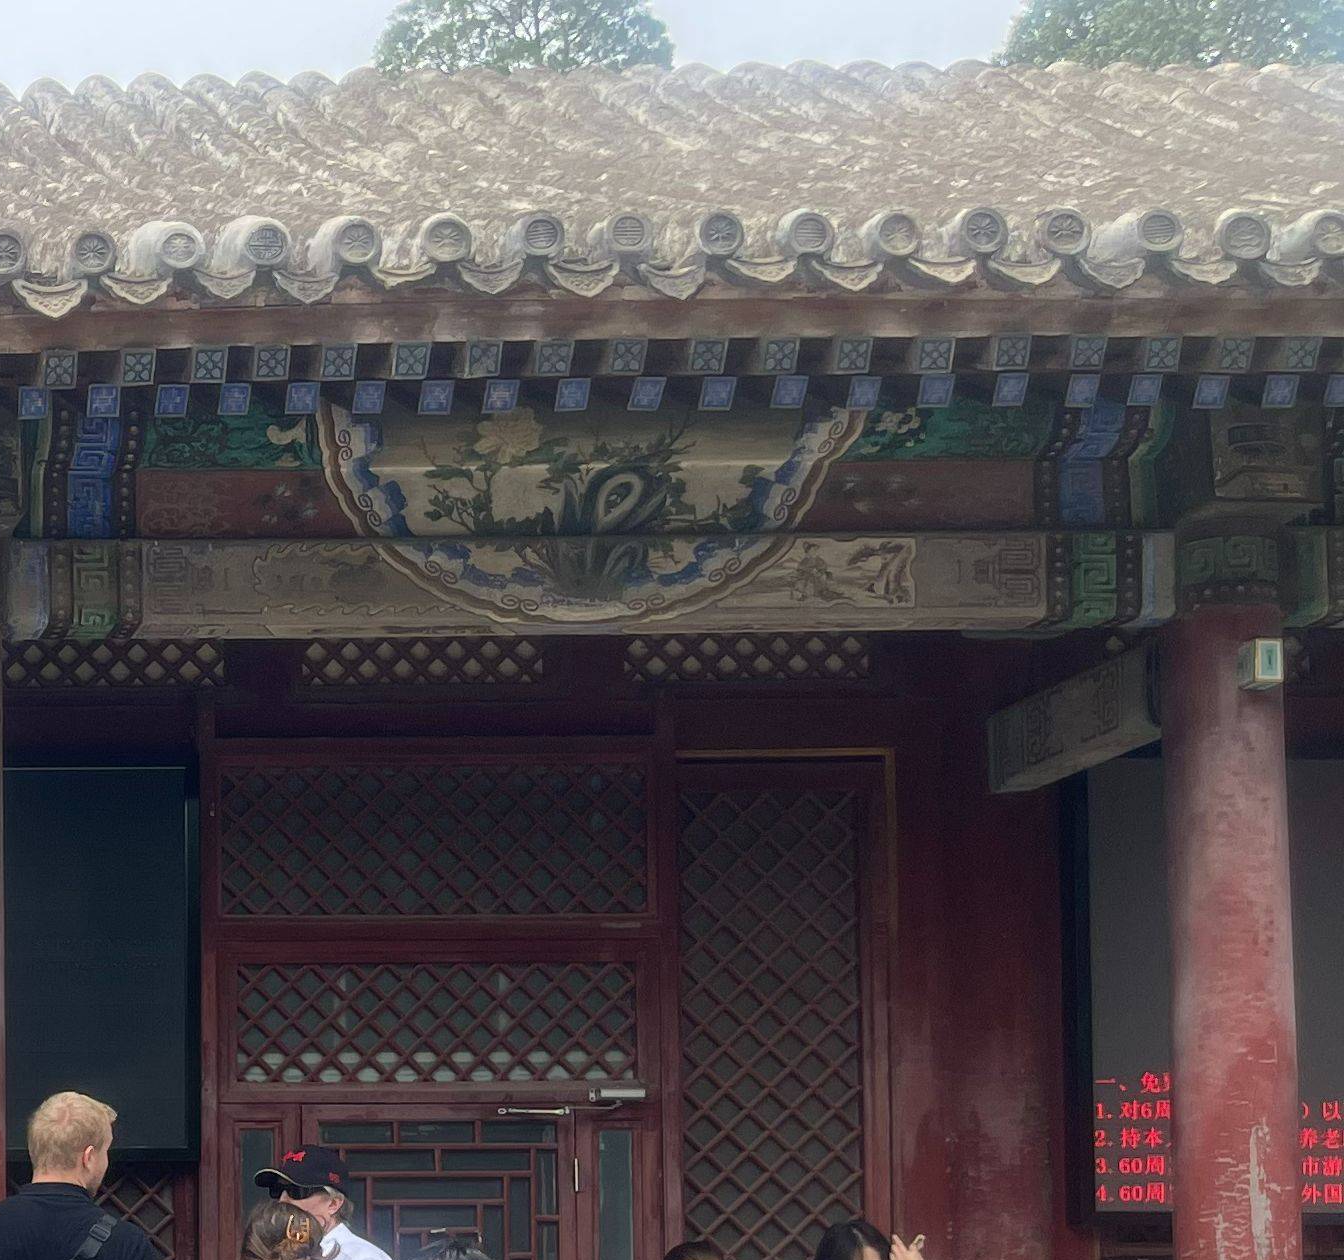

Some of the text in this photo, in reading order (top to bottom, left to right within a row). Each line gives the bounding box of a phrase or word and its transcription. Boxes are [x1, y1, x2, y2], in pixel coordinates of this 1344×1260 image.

[1303, 1100, 1344, 1120] ）以
[1094, 1127, 1344, 1149] 2.持本 养老
[1096, 1155, 1167, 1176] 3.60周
[1097, 1181, 1168, 1204] 4.60周
